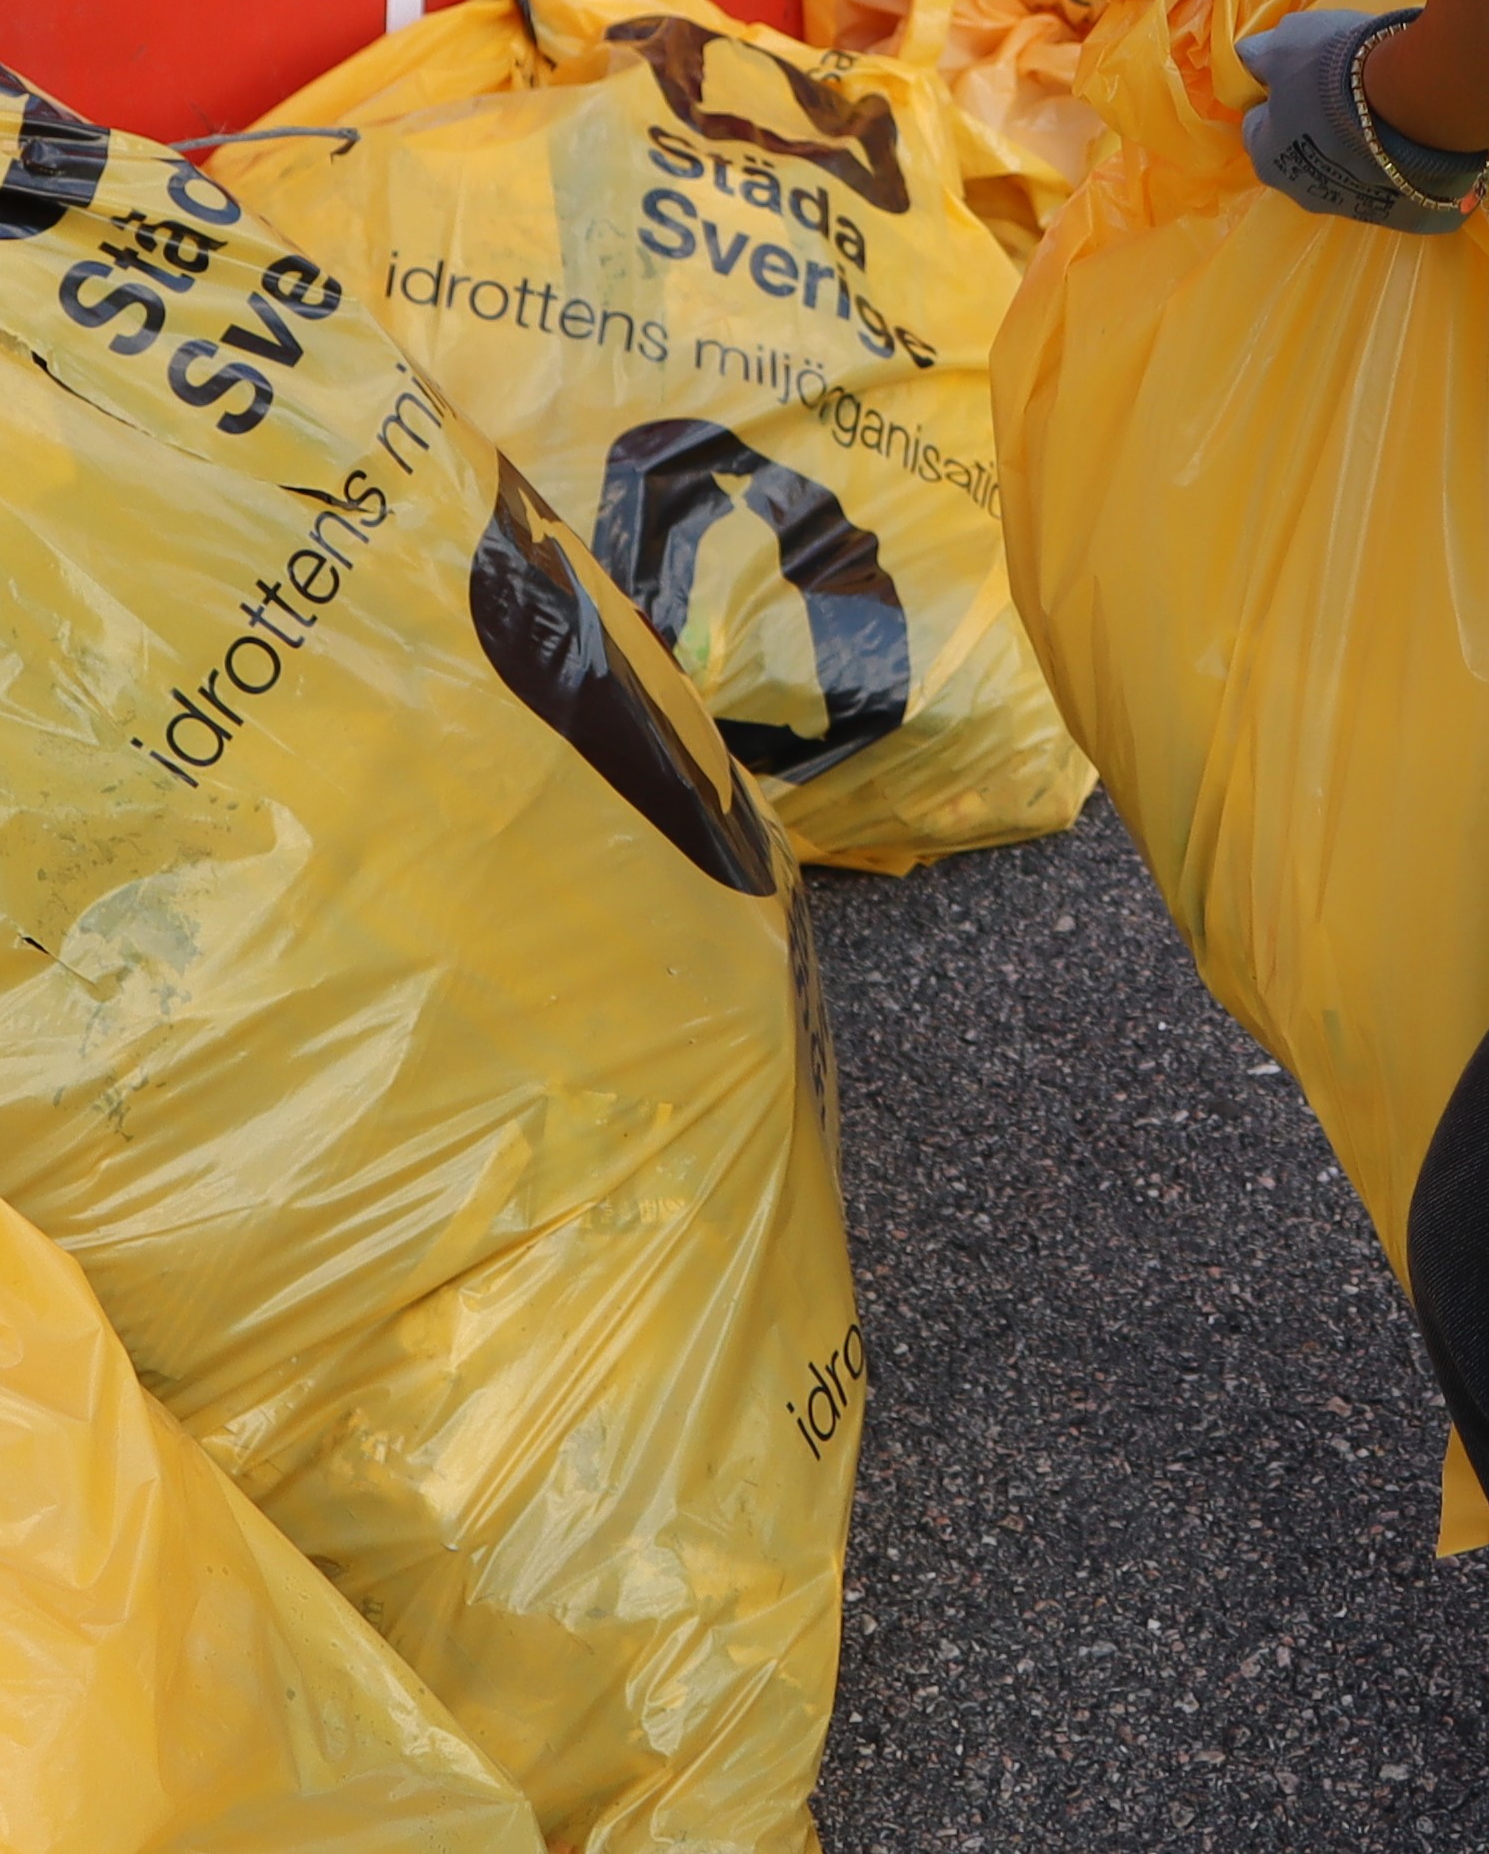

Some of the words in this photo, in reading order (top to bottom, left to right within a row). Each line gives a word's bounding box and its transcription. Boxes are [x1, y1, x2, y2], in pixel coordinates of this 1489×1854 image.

[637, 186, 939, 369] Sverige
[647, 124, 867, 273] Städa
[383, 249, 671, 364] idrottens
[130, 469, 388, 789] idrottens
